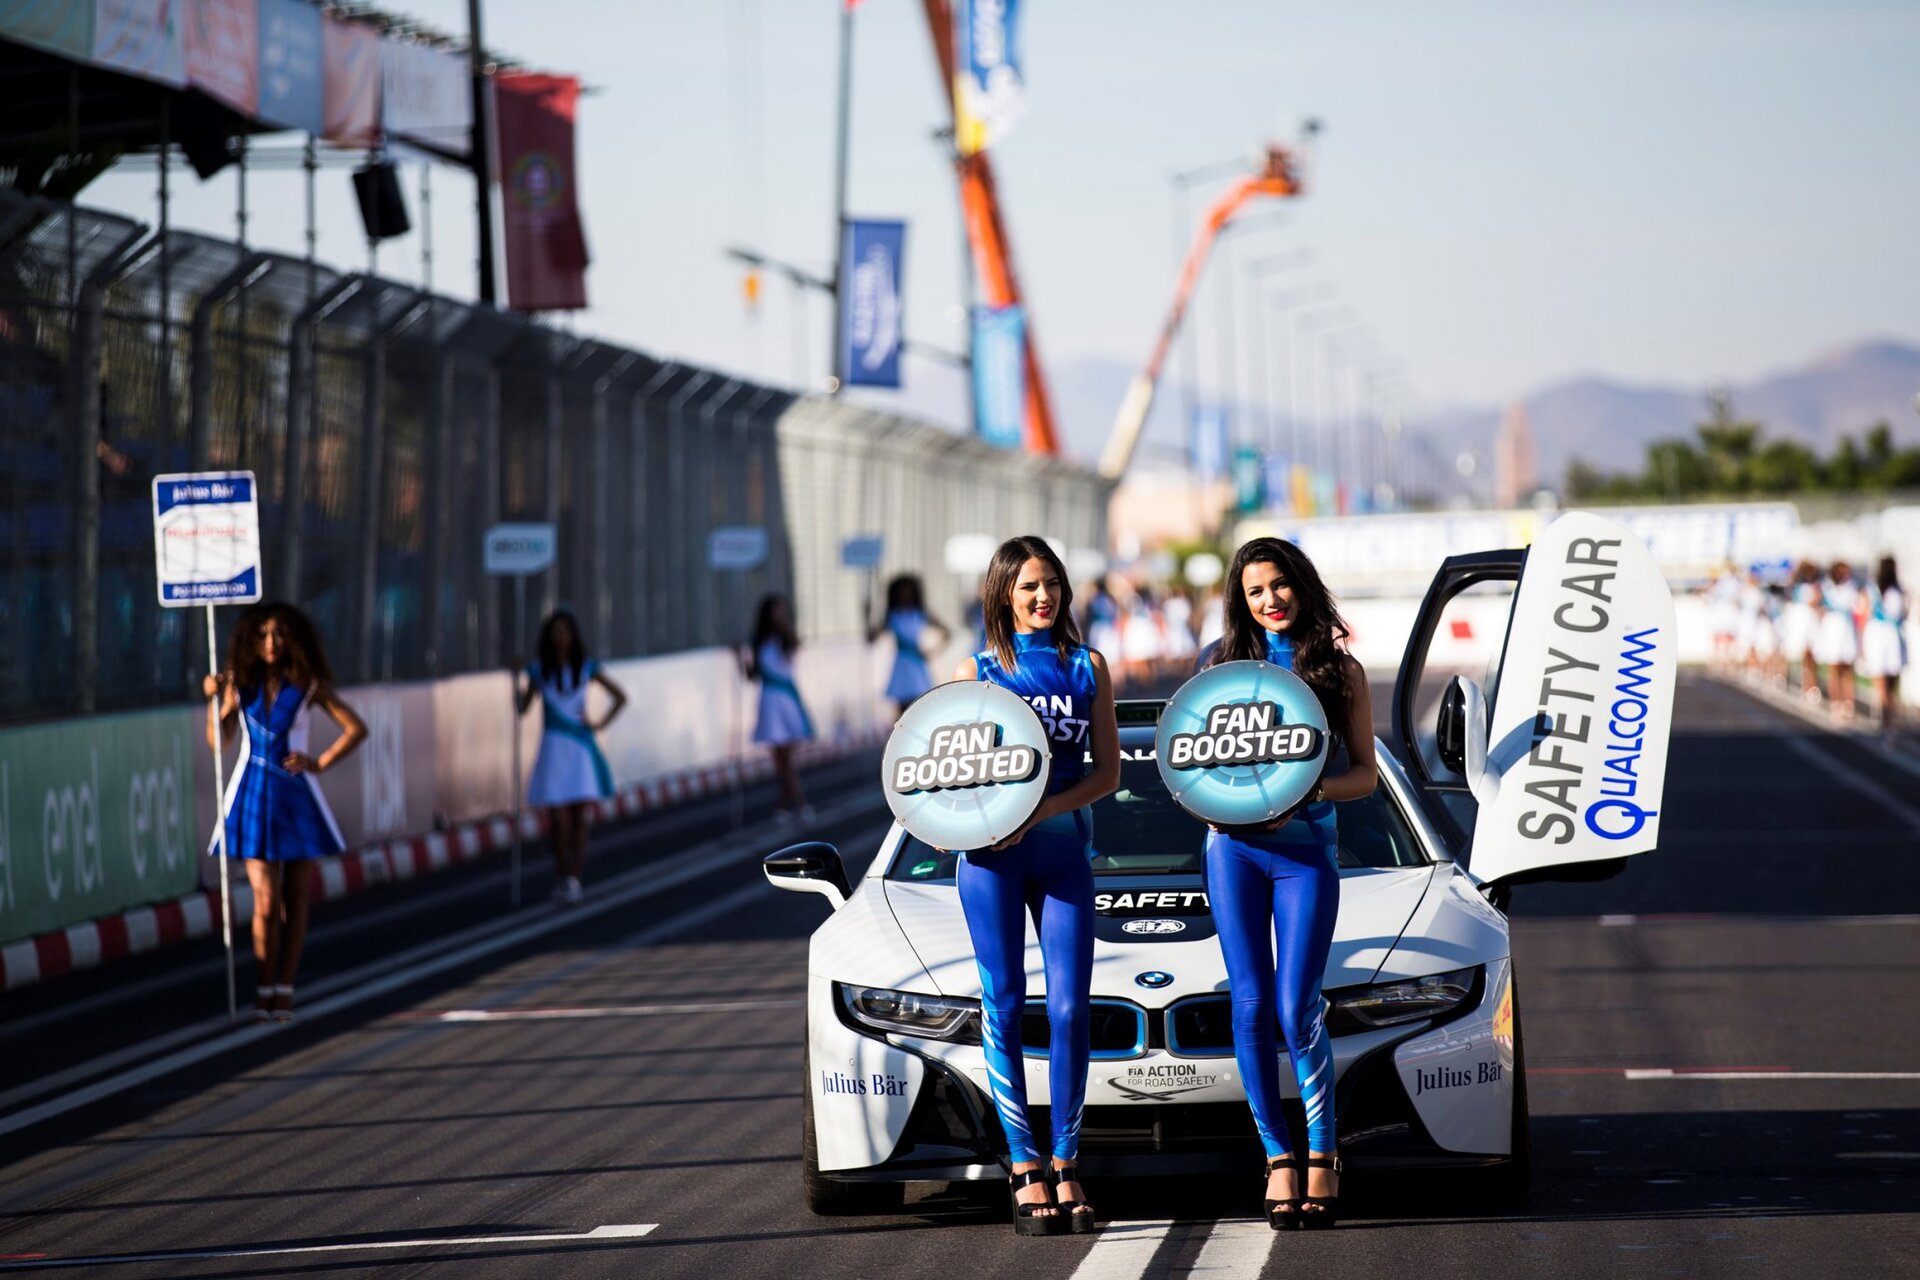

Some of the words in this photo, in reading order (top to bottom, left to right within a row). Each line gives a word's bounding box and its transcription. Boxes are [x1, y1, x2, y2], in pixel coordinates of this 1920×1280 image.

[1553, 537, 1622, 633] CAR
[1210, 705, 1271, 735] FAN
[1584, 628, 1659, 840] QUALCOMM
[932, 726, 992, 758] FAN
[1171, 727, 1311, 764] BOOSTED
[1517, 646, 1600, 844] SAFETY
[896, 749, 1030, 788] BOOSTED
[822, 1070, 867, 1095] Julius
[872, 1074, 908, 1096] Bär
[1127, 1078, 1143, 1086] FOR
[1145, 1077, 1174, 1087] ROAD
[1176, 1075, 1217, 1086] SAFETY
[1147, 1064, 1196, 1077] ACTION
[1416, 1066, 1472, 1096] Julius
[1476, 1061, 1503, 1084] Bär
